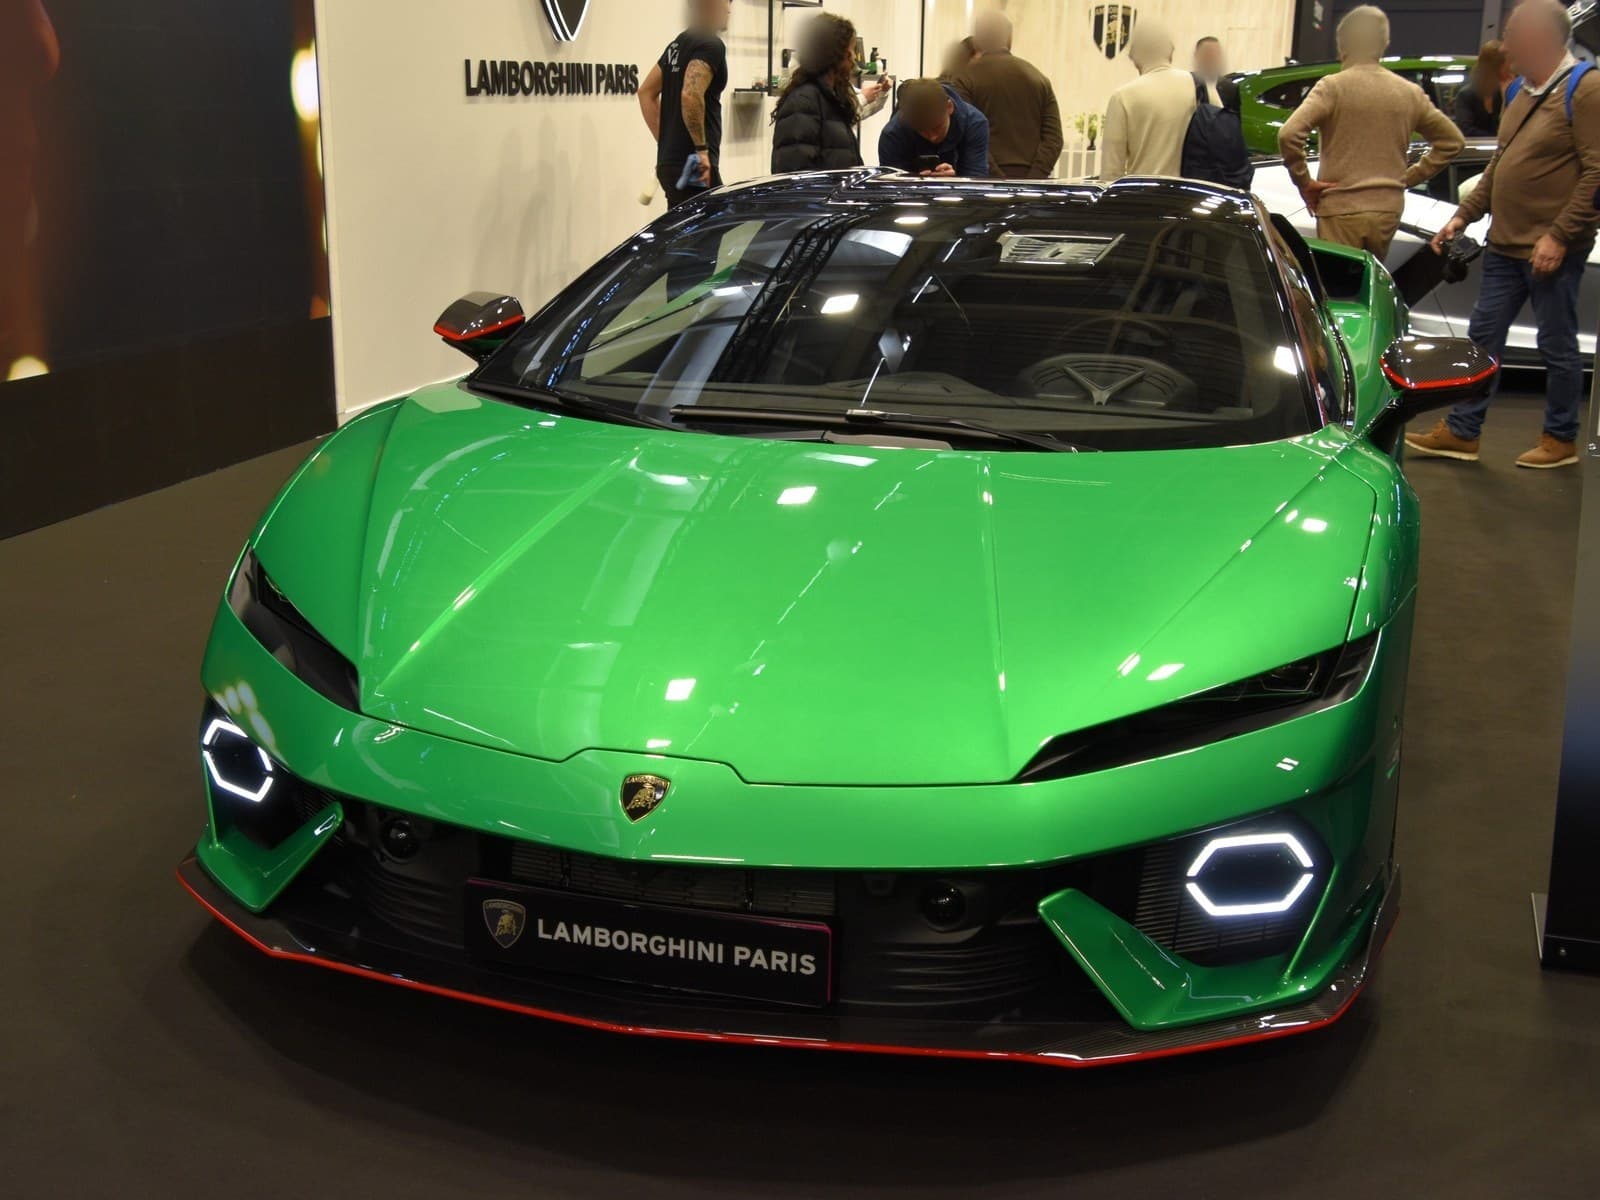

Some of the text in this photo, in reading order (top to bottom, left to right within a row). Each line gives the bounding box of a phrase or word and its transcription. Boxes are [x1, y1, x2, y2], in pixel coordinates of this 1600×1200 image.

[465, 59, 639, 97] LAMBORGHINI PARIS
[537, 918, 816, 975] LAMBORGHINI PARIS
